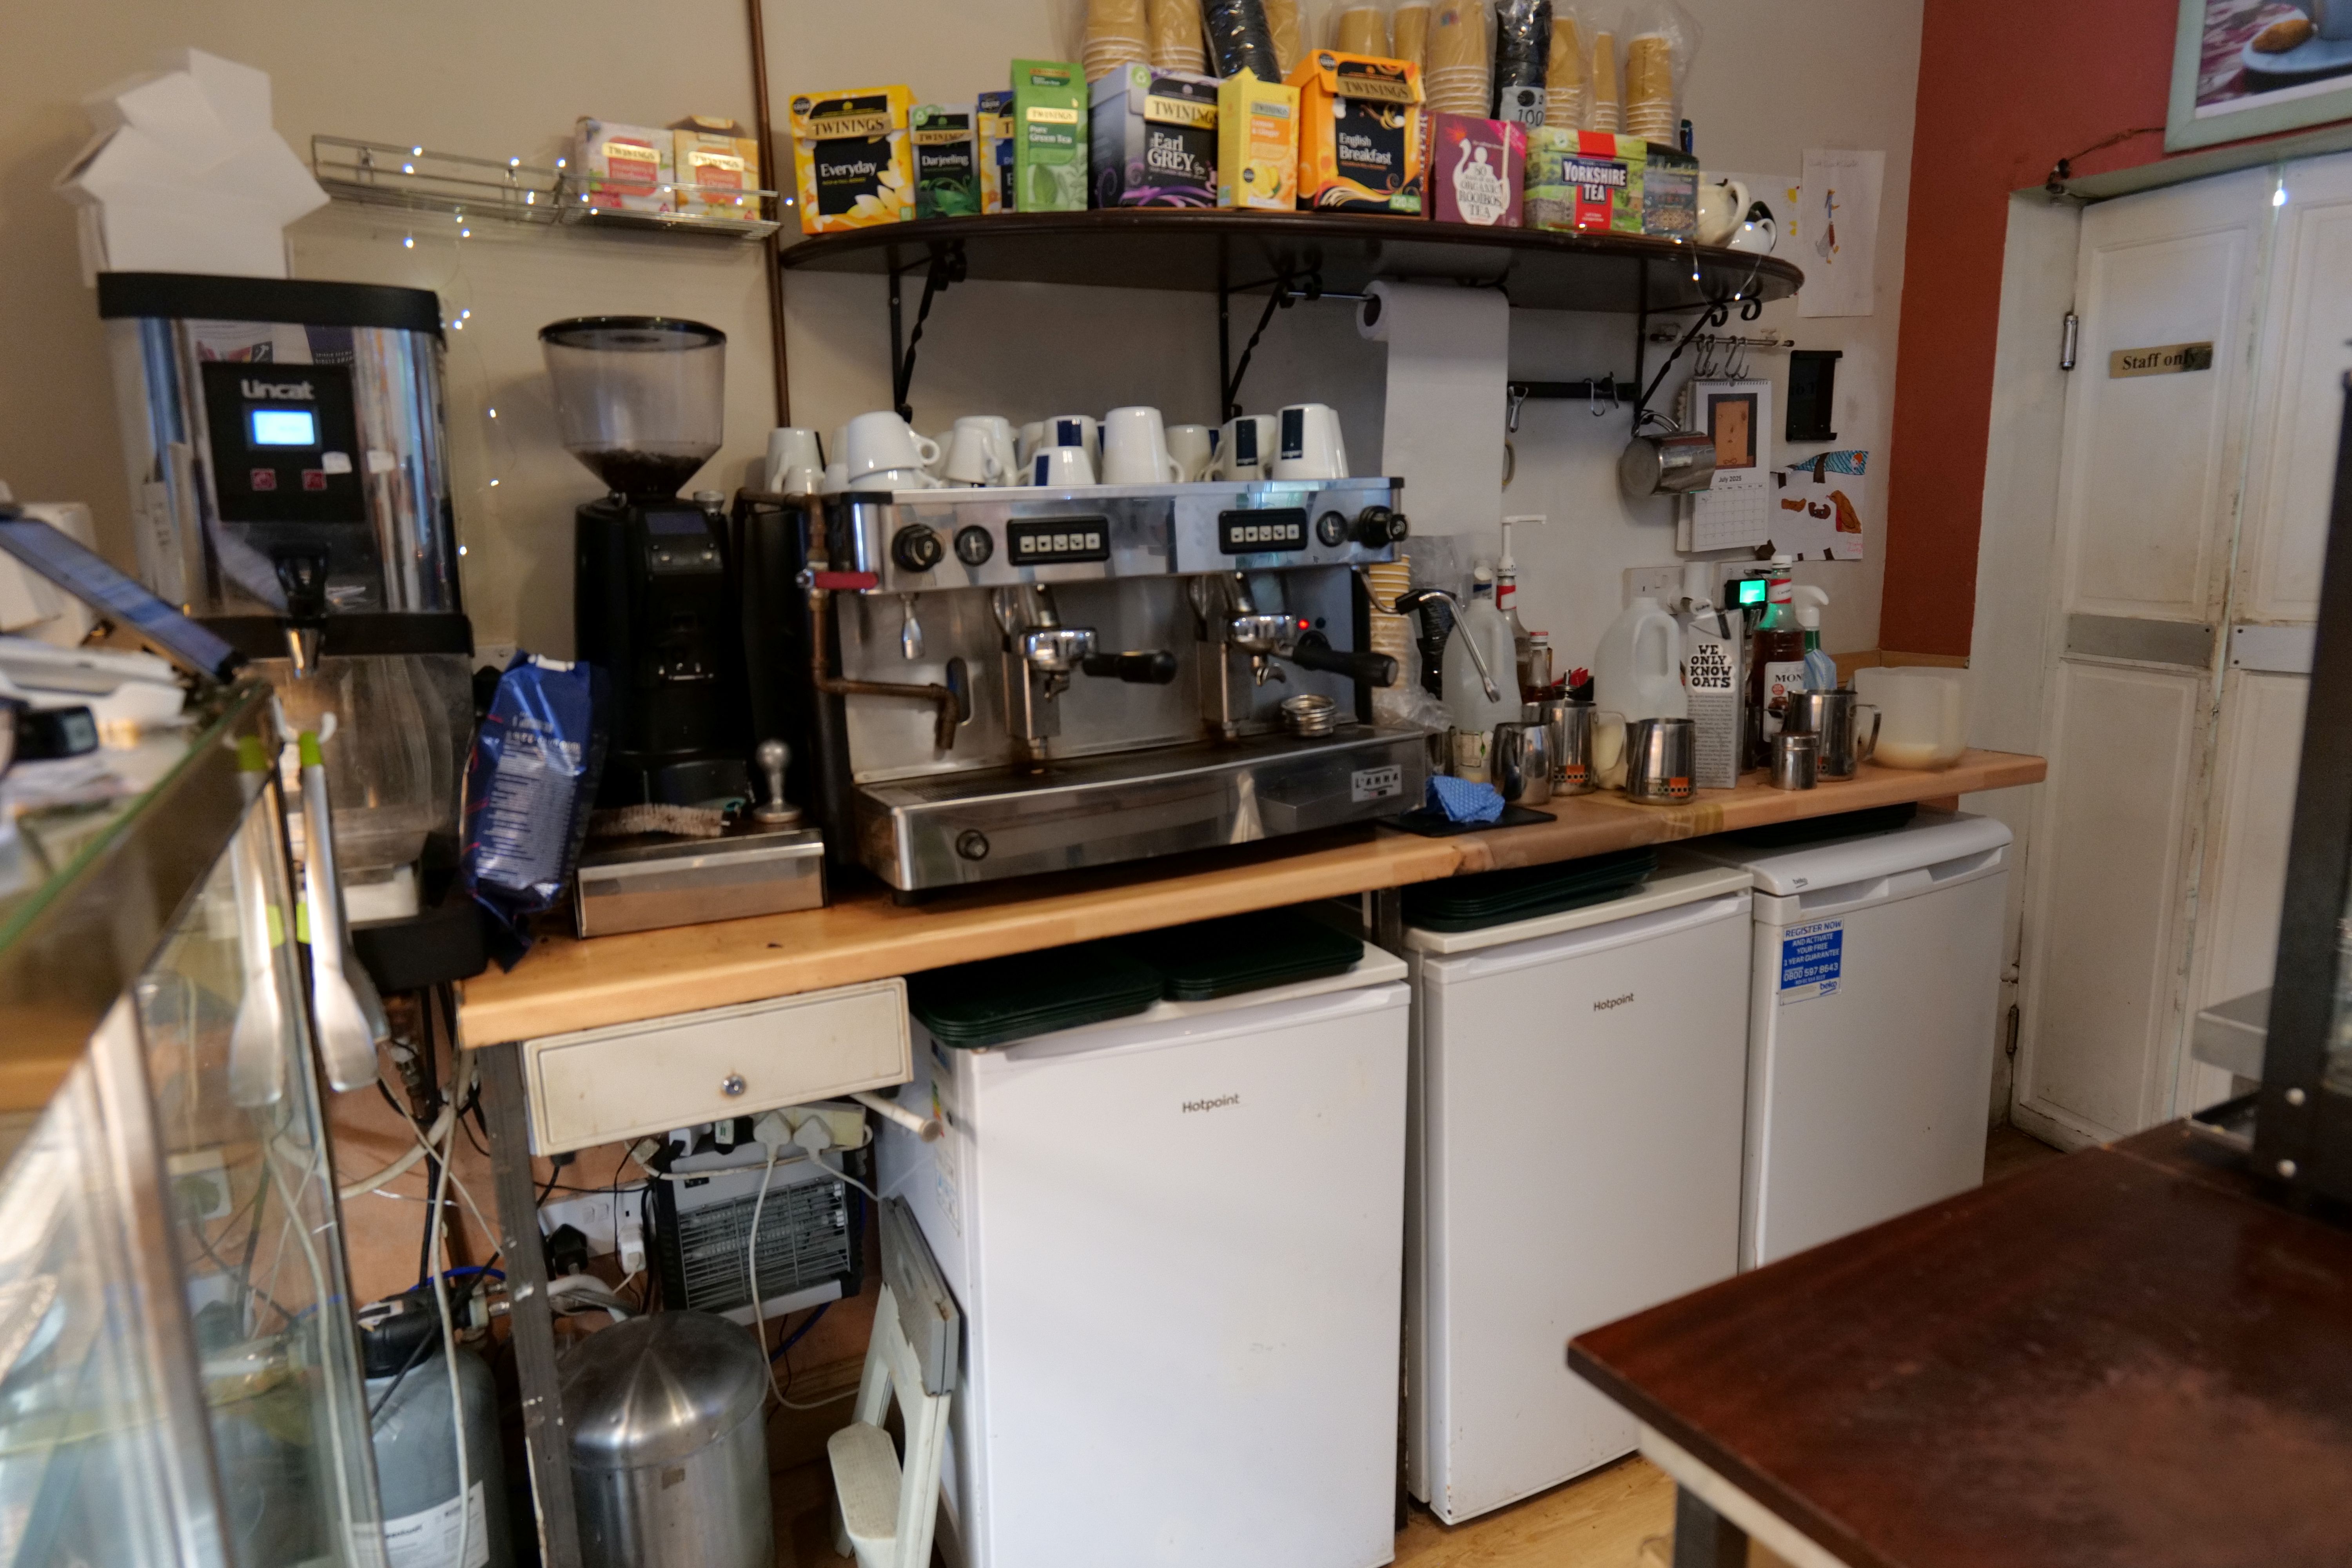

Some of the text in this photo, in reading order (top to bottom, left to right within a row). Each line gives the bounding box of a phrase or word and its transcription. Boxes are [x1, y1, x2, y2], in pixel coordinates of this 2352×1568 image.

[1344, 80, 1409, 99] TWININGS
[1033, 109, 1073, 119] TWININGS
[1154, 100, 1218, 124] TWININGS
[1517, 109, 1544, 127] 100
[813, 119, 885, 136] TWININGS
[1029, 125, 1048, 134] Pure
[1029, 133, 1073, 144] Green Tea
[1153, 132, 1183, 152] Earl
[1339, 132, 1372, 148] English
[922, 154, 969, 167] Darjeeling
[1147, 147, 1196, 172] GREY
[1339, 145, 1392, 165] Breakfast
[820, 160, 877, 178] Everyday
[1461, 180, 1500, 194] ORGANIC
[1584, 184, 1605, 201] TEA
[1459, 189, 1502, 207] ROOIBOS
[1469, 203, 1492, 219] TEA
[2123, 352, 2161, 371] Staff
[240, 379, 315, 400] Lincat
[1698, 645, 1719, 655] WE
[1691, 655, 1727, 665] ONLY
[1690, 666, 1732, 676] KNOW
[1775, 673, 1803, 682] MON
[1691, 677, 1731, 688] OATS
[1786, 920, 1842, 938] REGISTER NOW
[1792, 932, 1834, 947] AND ACTIVATE
[1788, 956, 1805, 965] YEAR
[1805, 948, 1840, 962] GUARANTEE
[1797, 942, 1828, 955] YOUR FREE
[1784, 970, 1803, 982] 0800
[1804, 966, 1818, 977] 597
[1819, 962, 1838, 974] 8643
[1820, 981, 1837, 990] beko
[1593, 992, 1634, 1012] Hotpoint
[1182, 1094, 1239, 1113] Hotpoint
